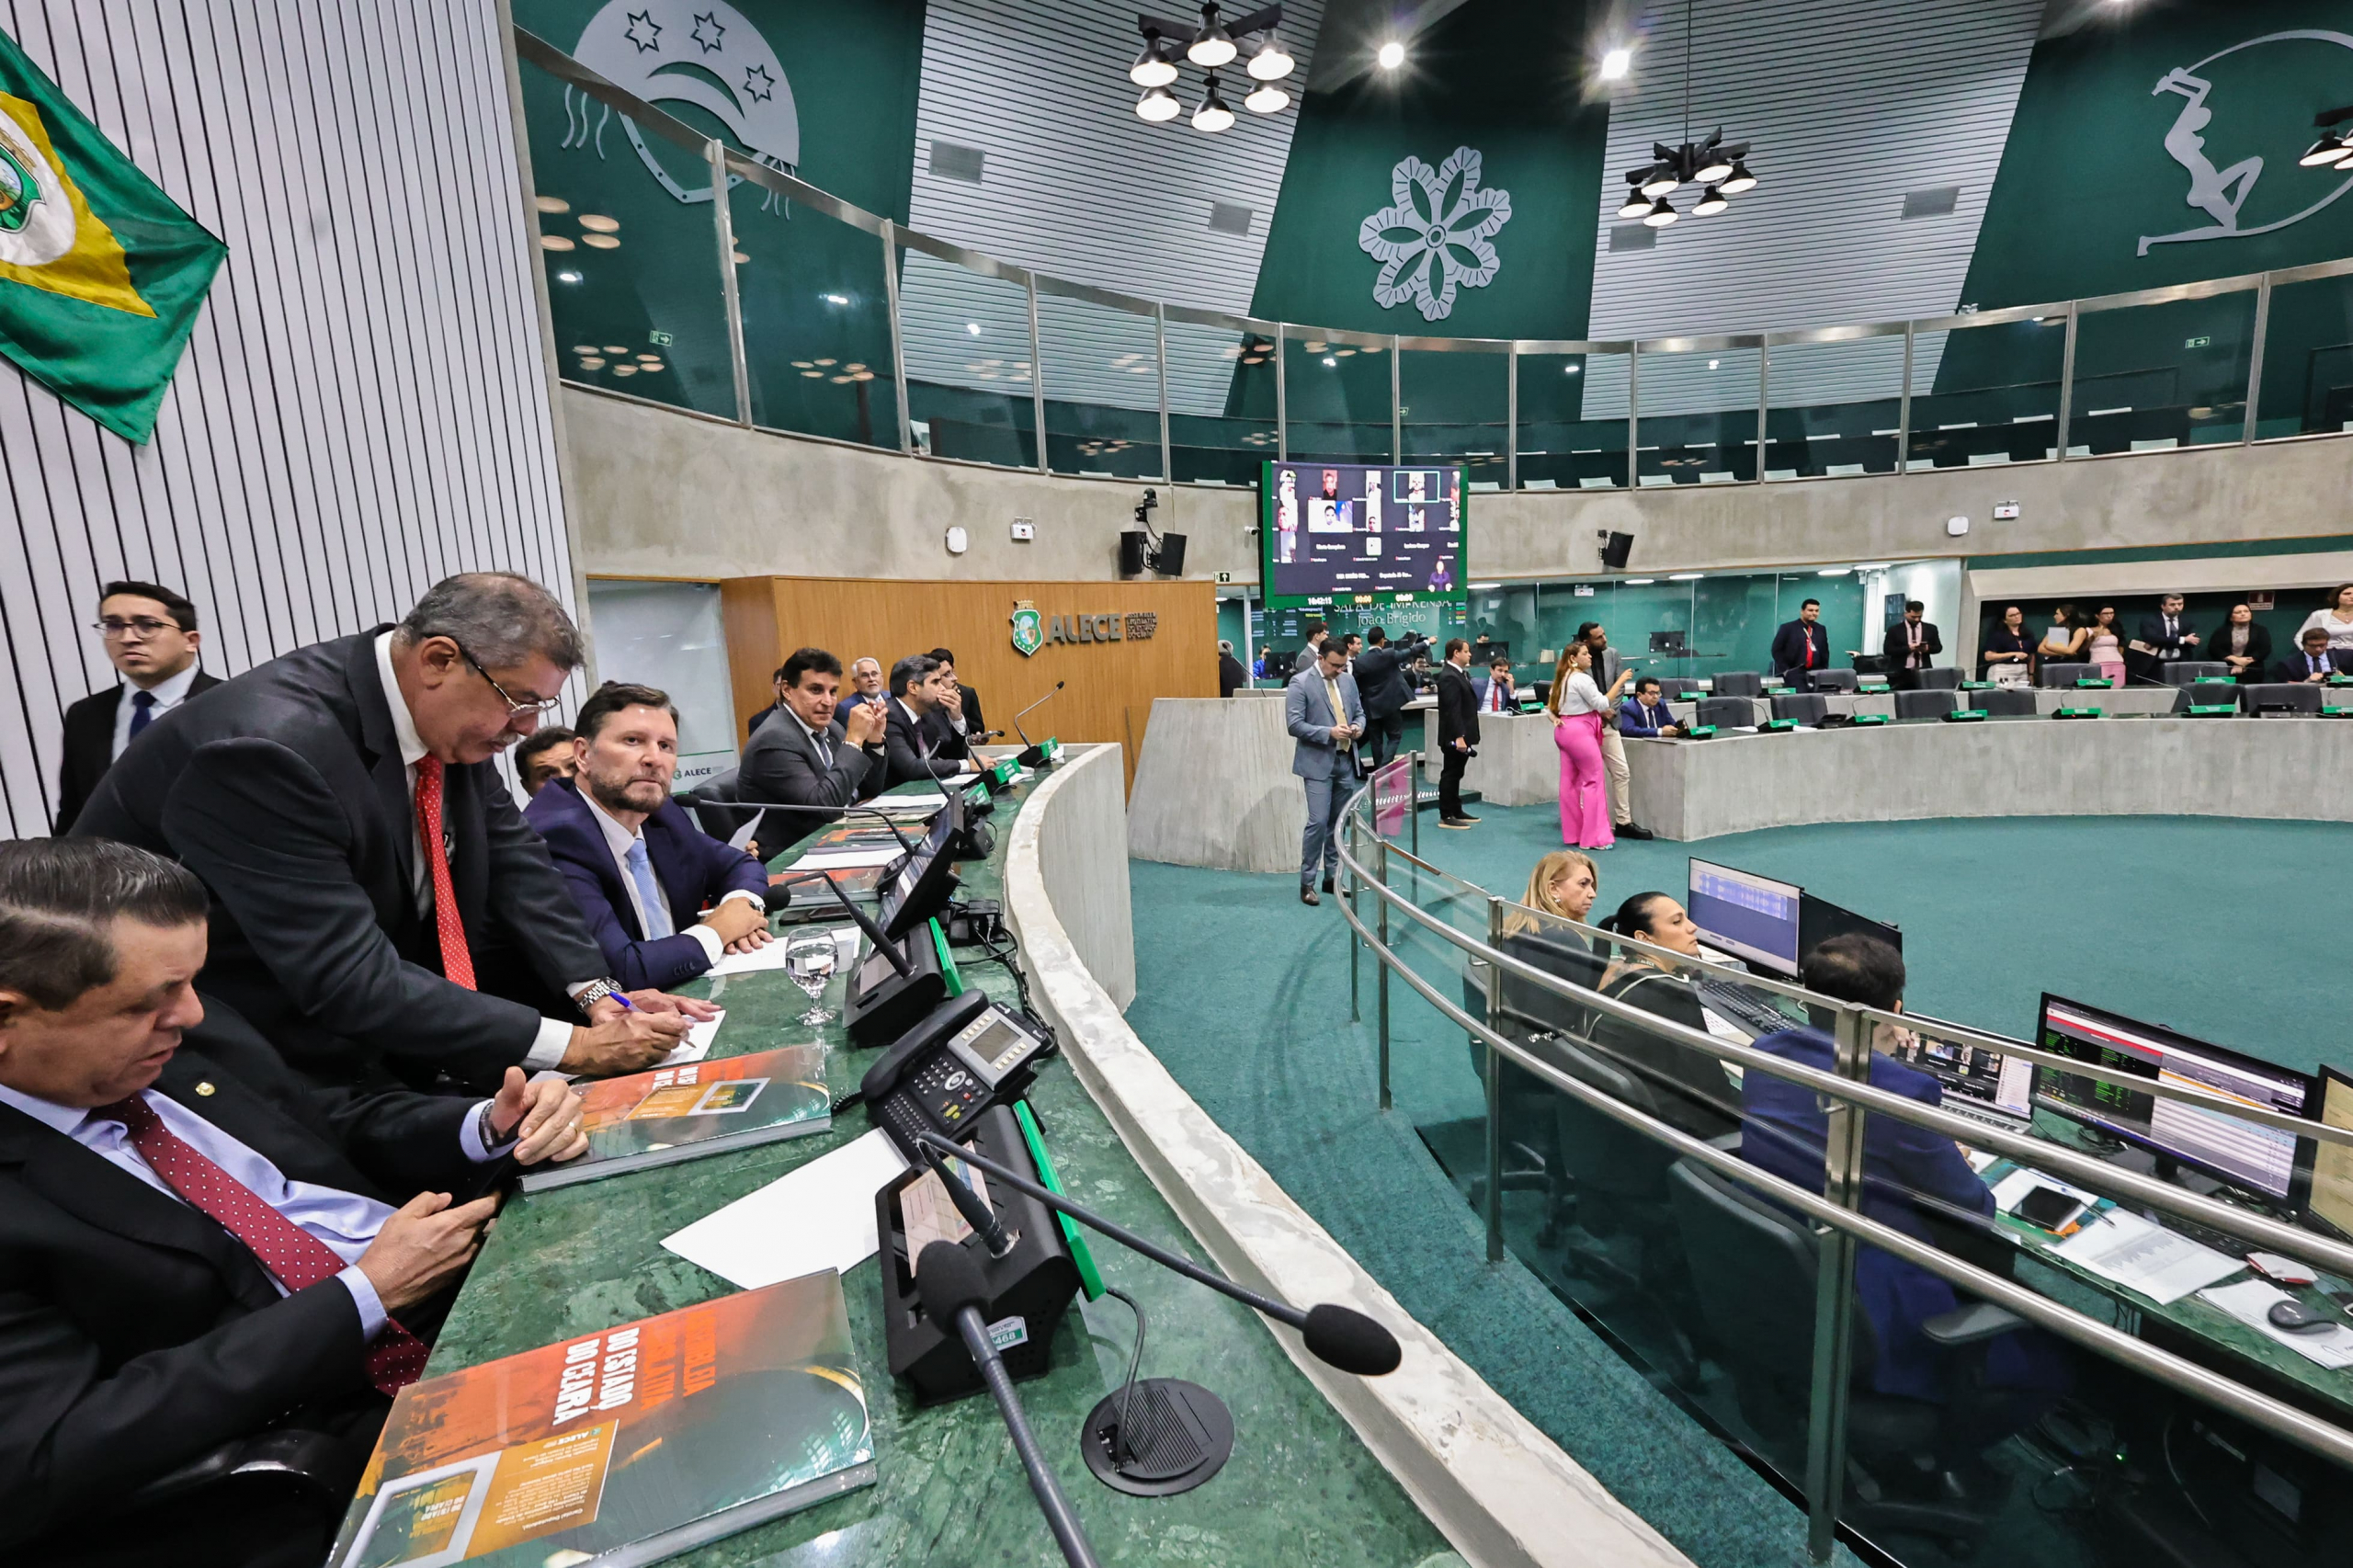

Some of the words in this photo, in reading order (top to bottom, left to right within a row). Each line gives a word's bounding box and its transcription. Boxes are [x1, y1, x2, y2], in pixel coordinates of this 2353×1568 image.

[1048, 614, 1122, 645] ALECE
[1386, 610, 1427, 628] Brígido
[684, 767, 711, 778] ALECE
[564, 1338, 601, 1364] DO
[607, 1327, 640, 1353] DO
[597, 1347, 638, 1411] ESTADO
[552, 1361, 597, 1426] CEARÁ
[558, 1431, 588, 1444] ALECE
